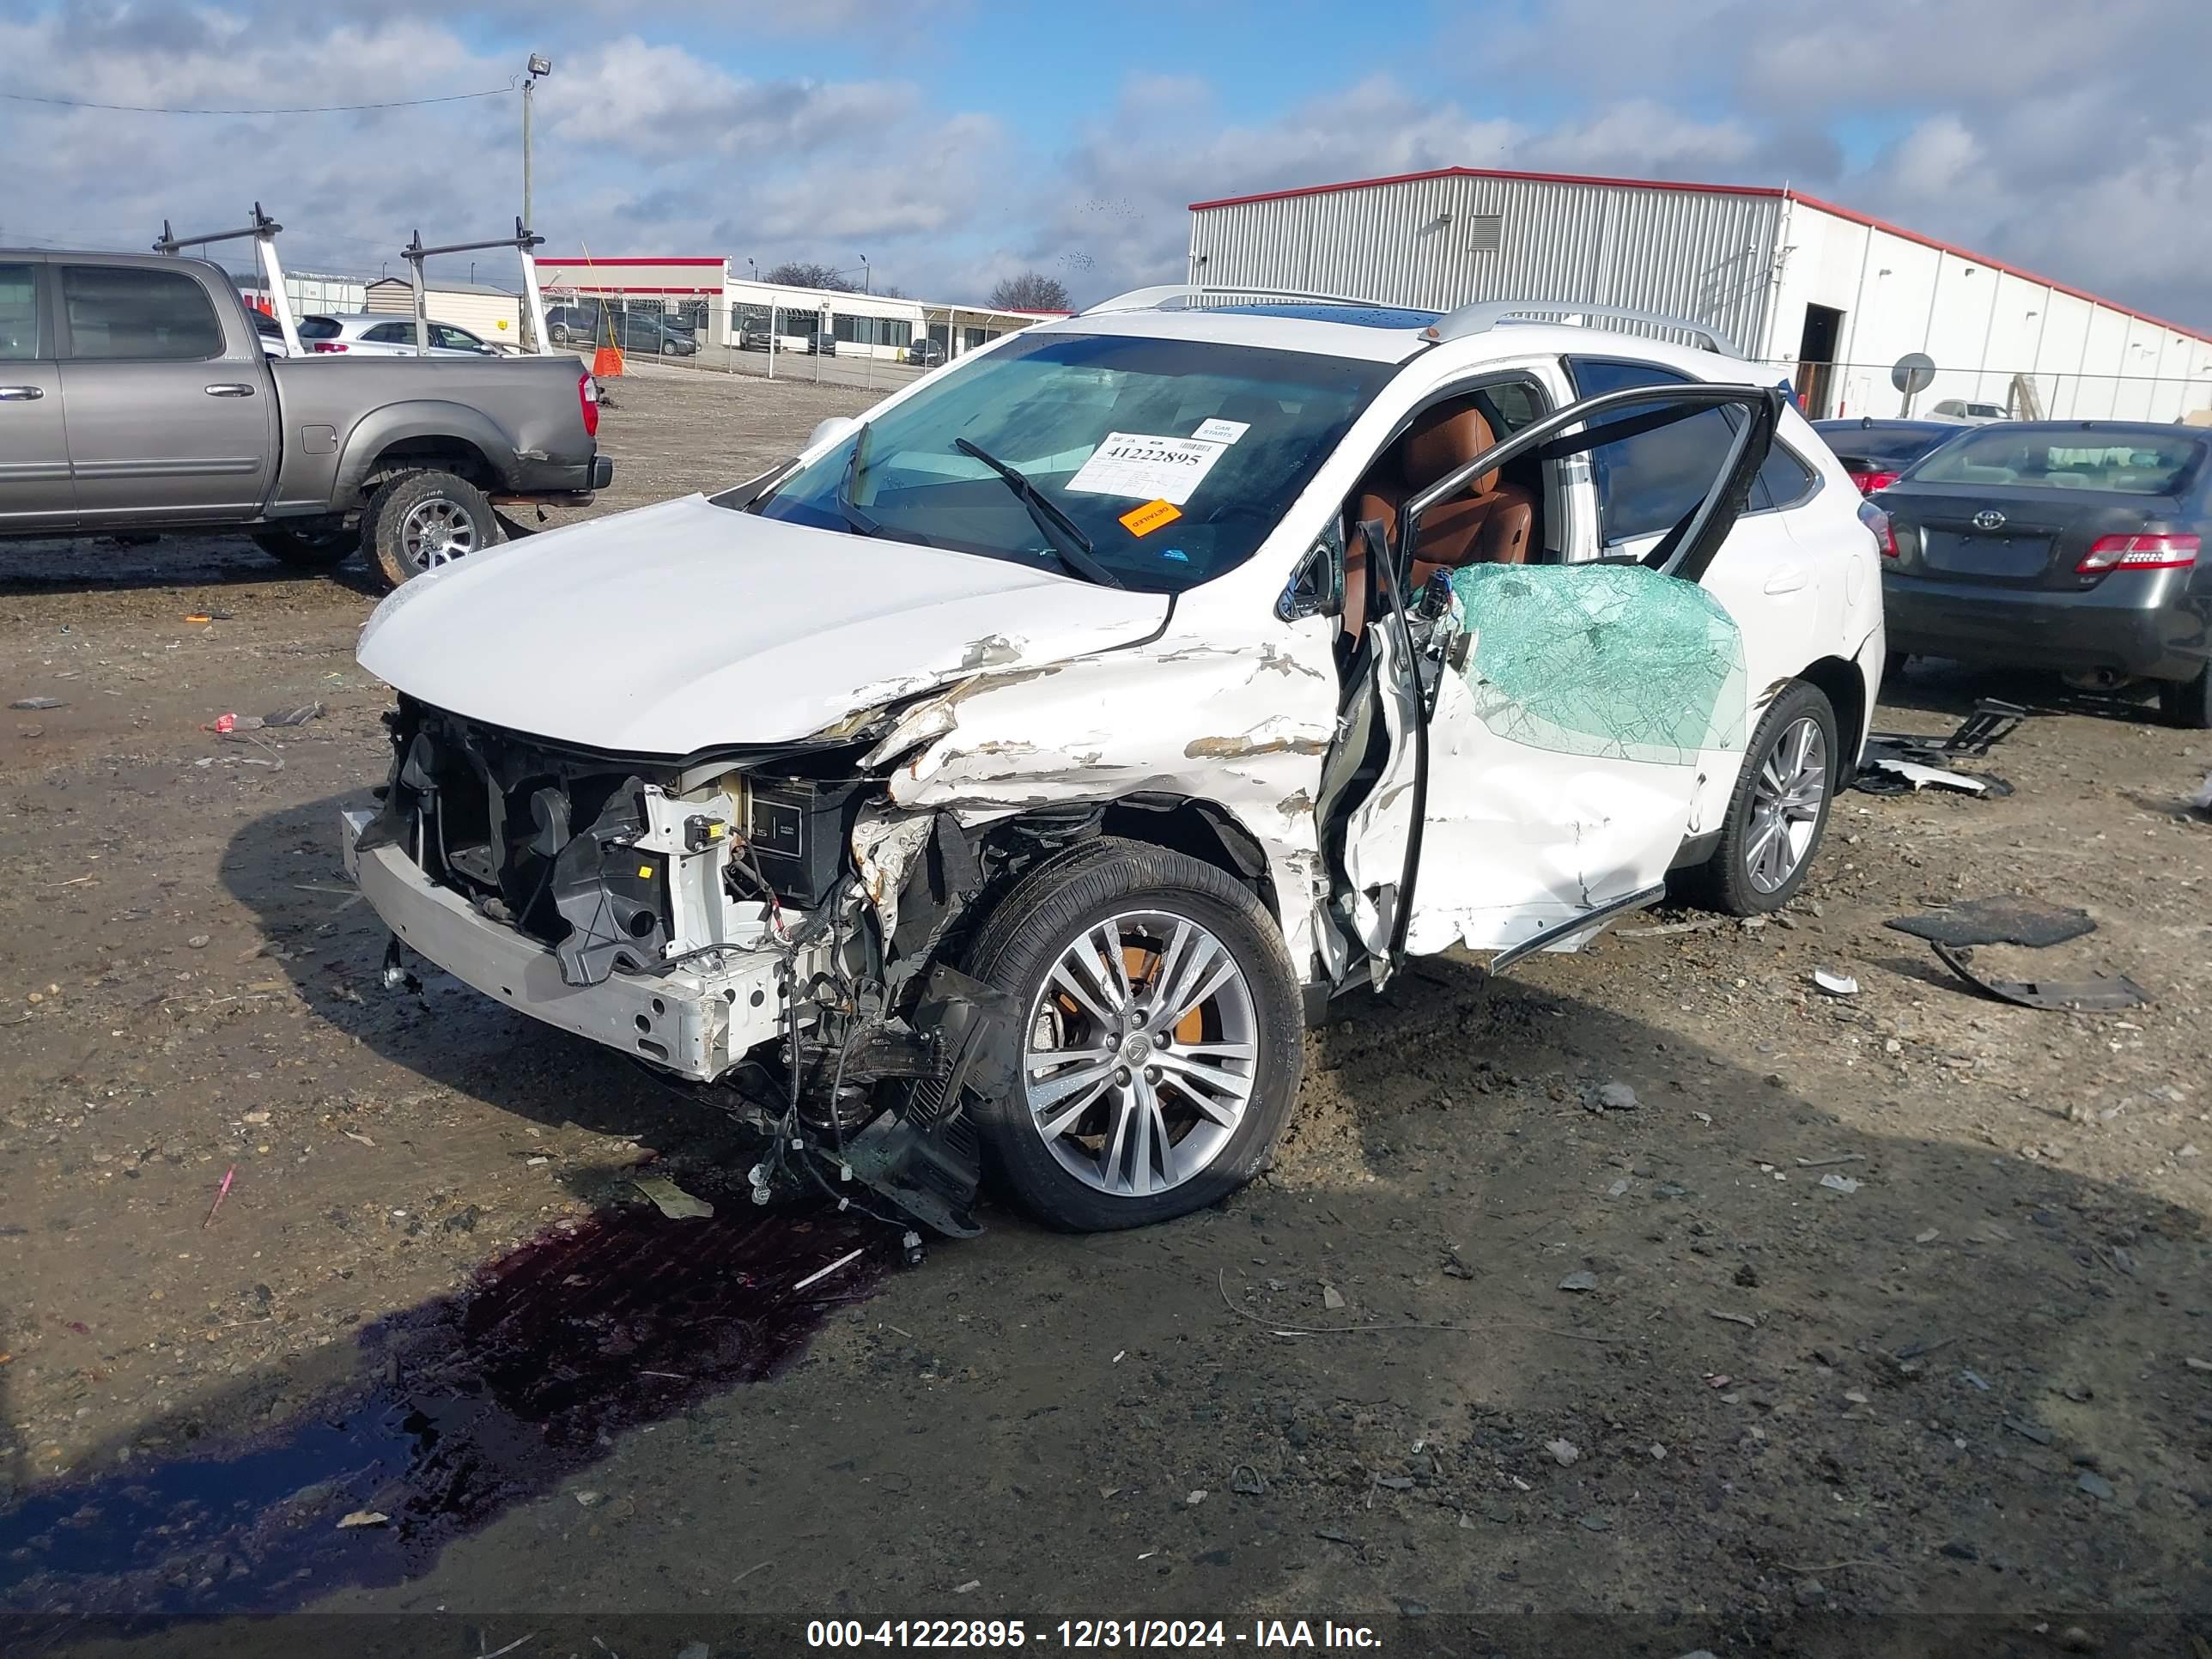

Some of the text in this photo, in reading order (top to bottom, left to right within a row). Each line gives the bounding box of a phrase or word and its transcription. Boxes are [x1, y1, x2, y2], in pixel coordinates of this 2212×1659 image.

[1203, 429, 1234, 438] STARTS
[1107, 446, 1202, 466] 41222895
[1132, 506, 1170, 527] DETAILED
